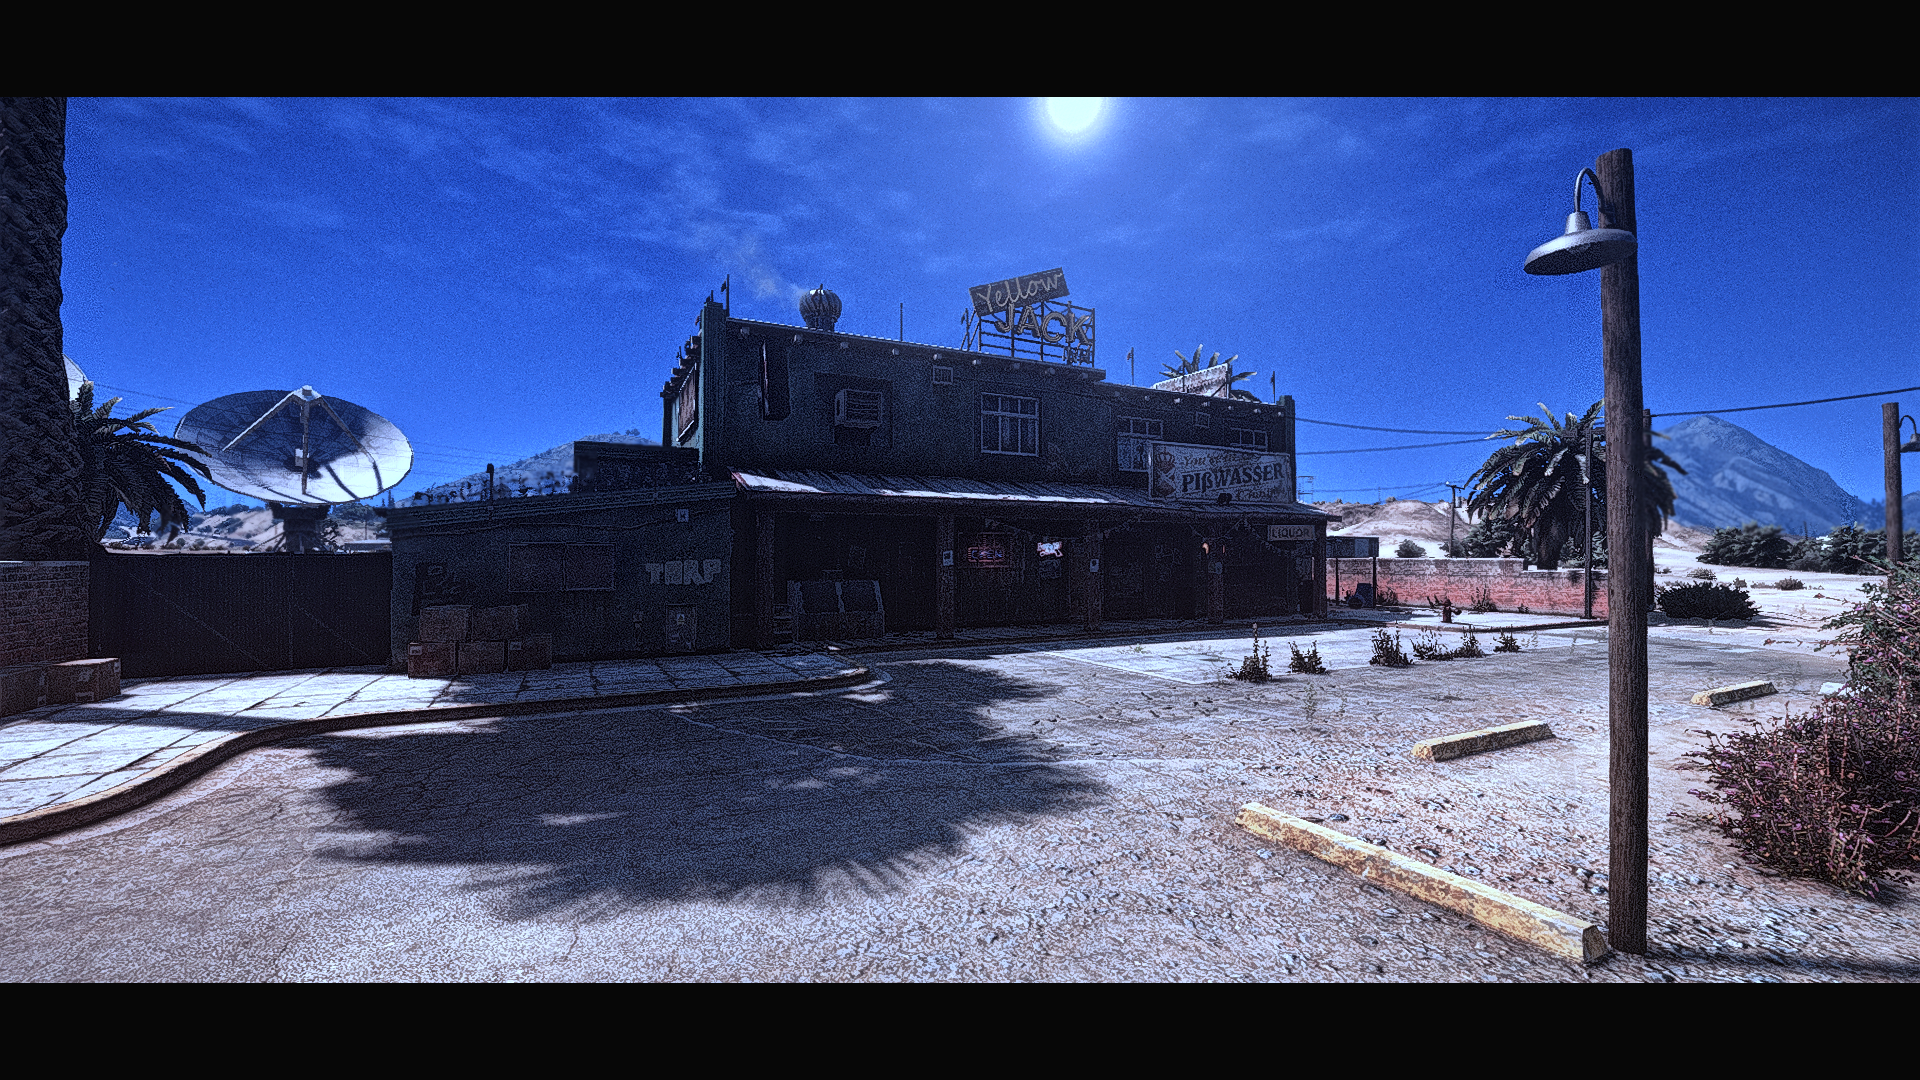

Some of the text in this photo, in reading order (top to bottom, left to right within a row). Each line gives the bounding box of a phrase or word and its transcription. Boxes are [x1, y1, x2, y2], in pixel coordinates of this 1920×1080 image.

[976, 272, 1063, 312] Yellow
[994, 302, 1091, 345] JACK
[1272, 528, 1310, 538] LIQUOR
